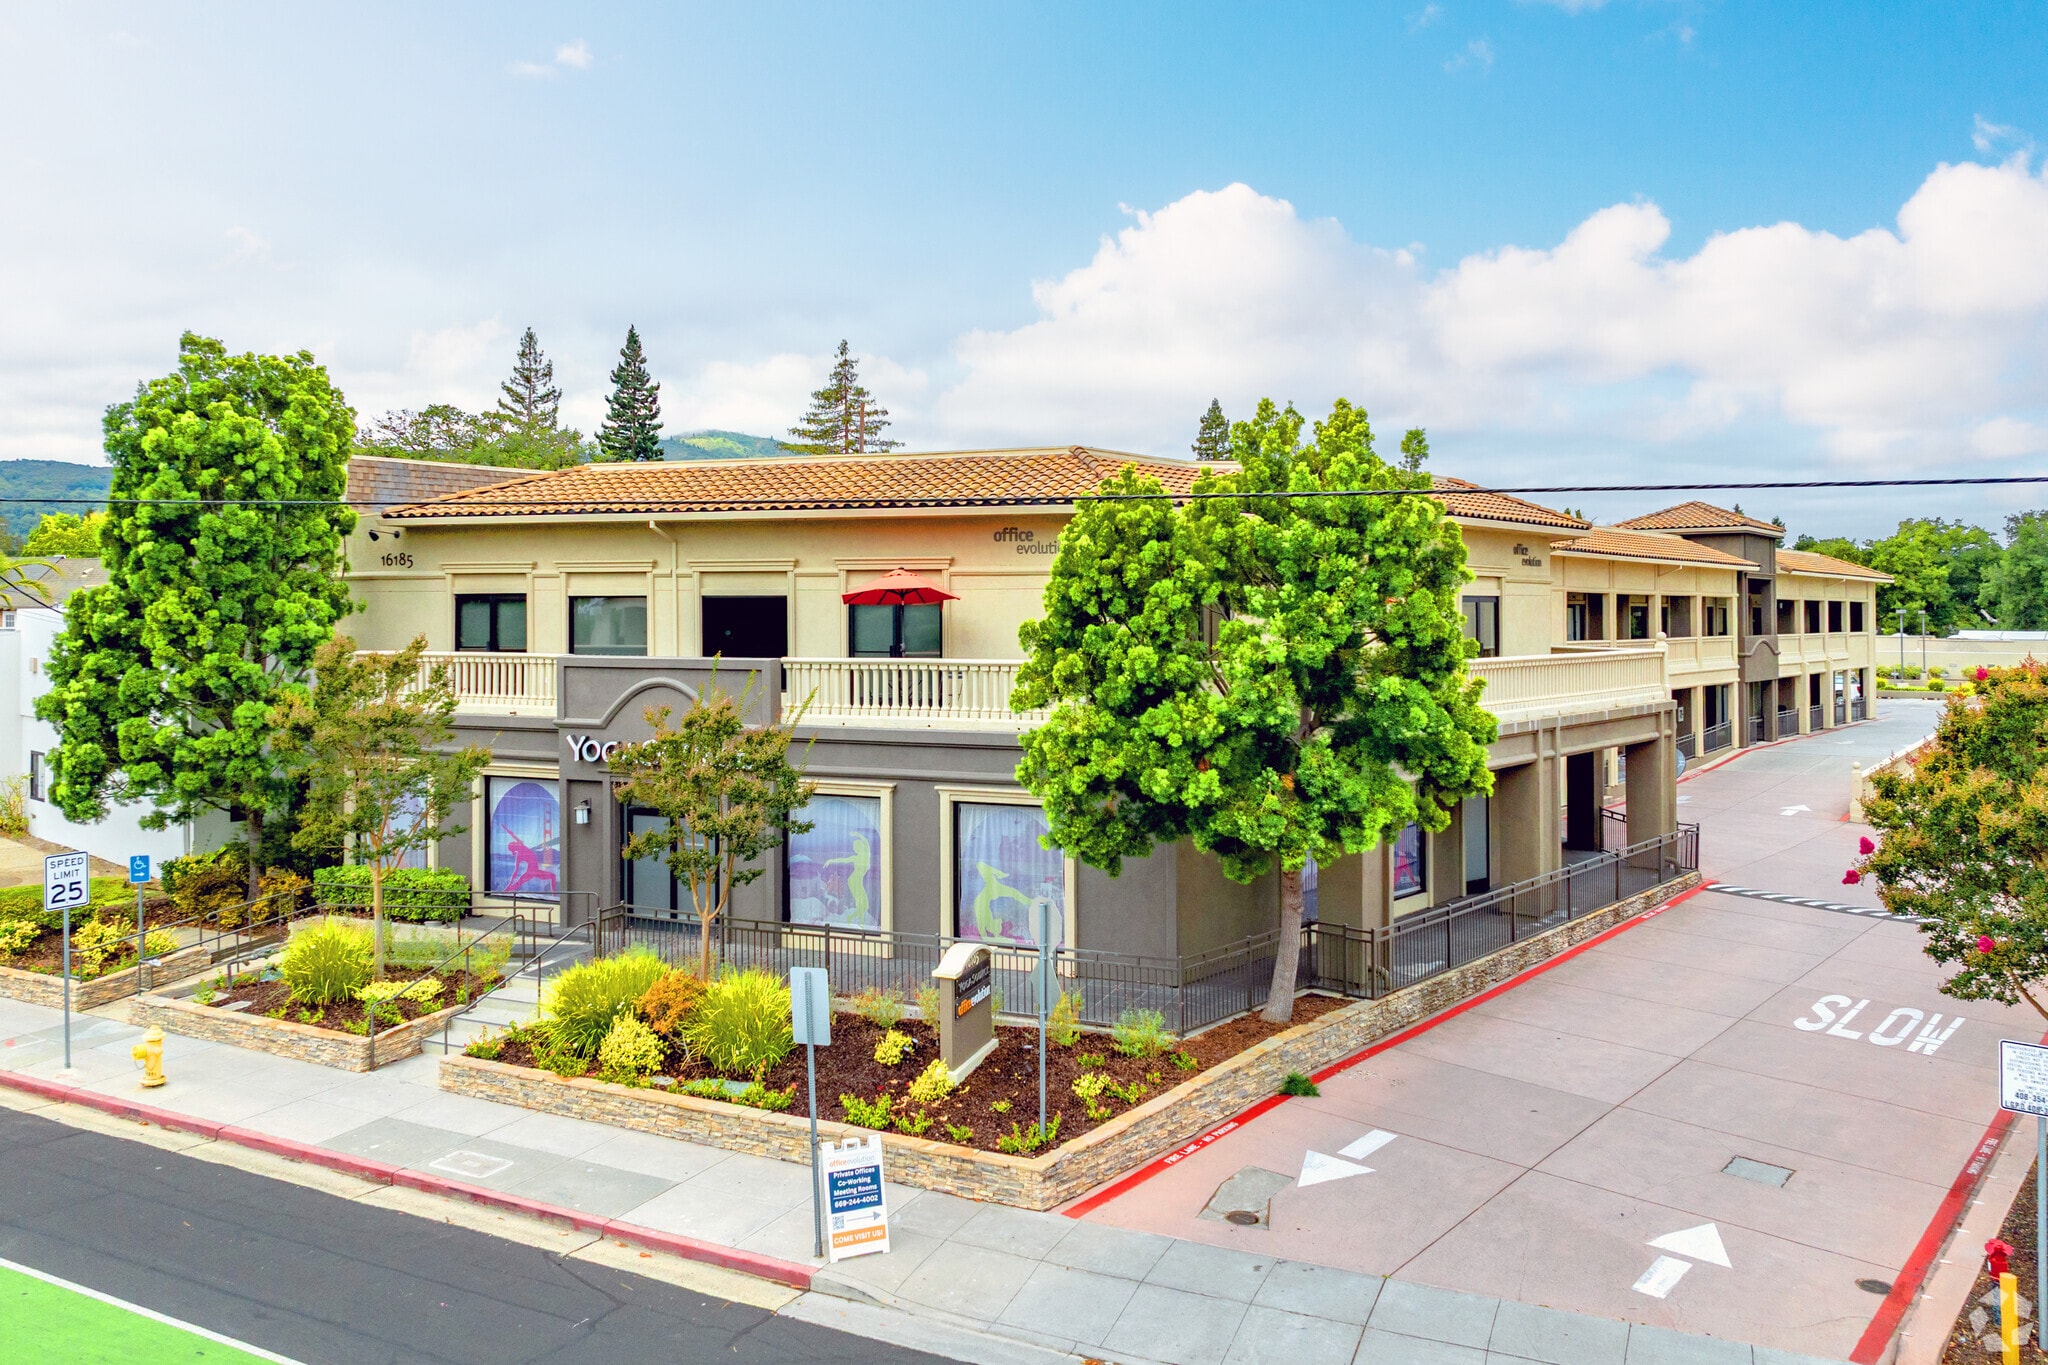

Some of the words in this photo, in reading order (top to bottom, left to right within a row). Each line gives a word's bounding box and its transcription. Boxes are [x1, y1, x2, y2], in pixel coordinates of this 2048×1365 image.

[993, 526, 1034, 543] office
[1016, 541, 1064, 555] evoluti
[381, 552, 414, 569] 16185
[50, 857, 84, 869] SPEED
[53, 869, 80, 880] LIMIT
[51, 881, 83, 904] 25
[1793, 994, 1966, 1056] SLOW
[833, 1170, 854, 1179] Private
[855, 1167, 875, 1175] Offices
[837, 1176, 871, 1187] Co-Working
[833, 1187, 857, 1197] Meeting
[858, 1184, 878, 1193] Rooms
[834, 1235, 854, 1245] COME
[854, 1231, 871, 1240] VISIT
[872, 1229, 884, 1238] US!
